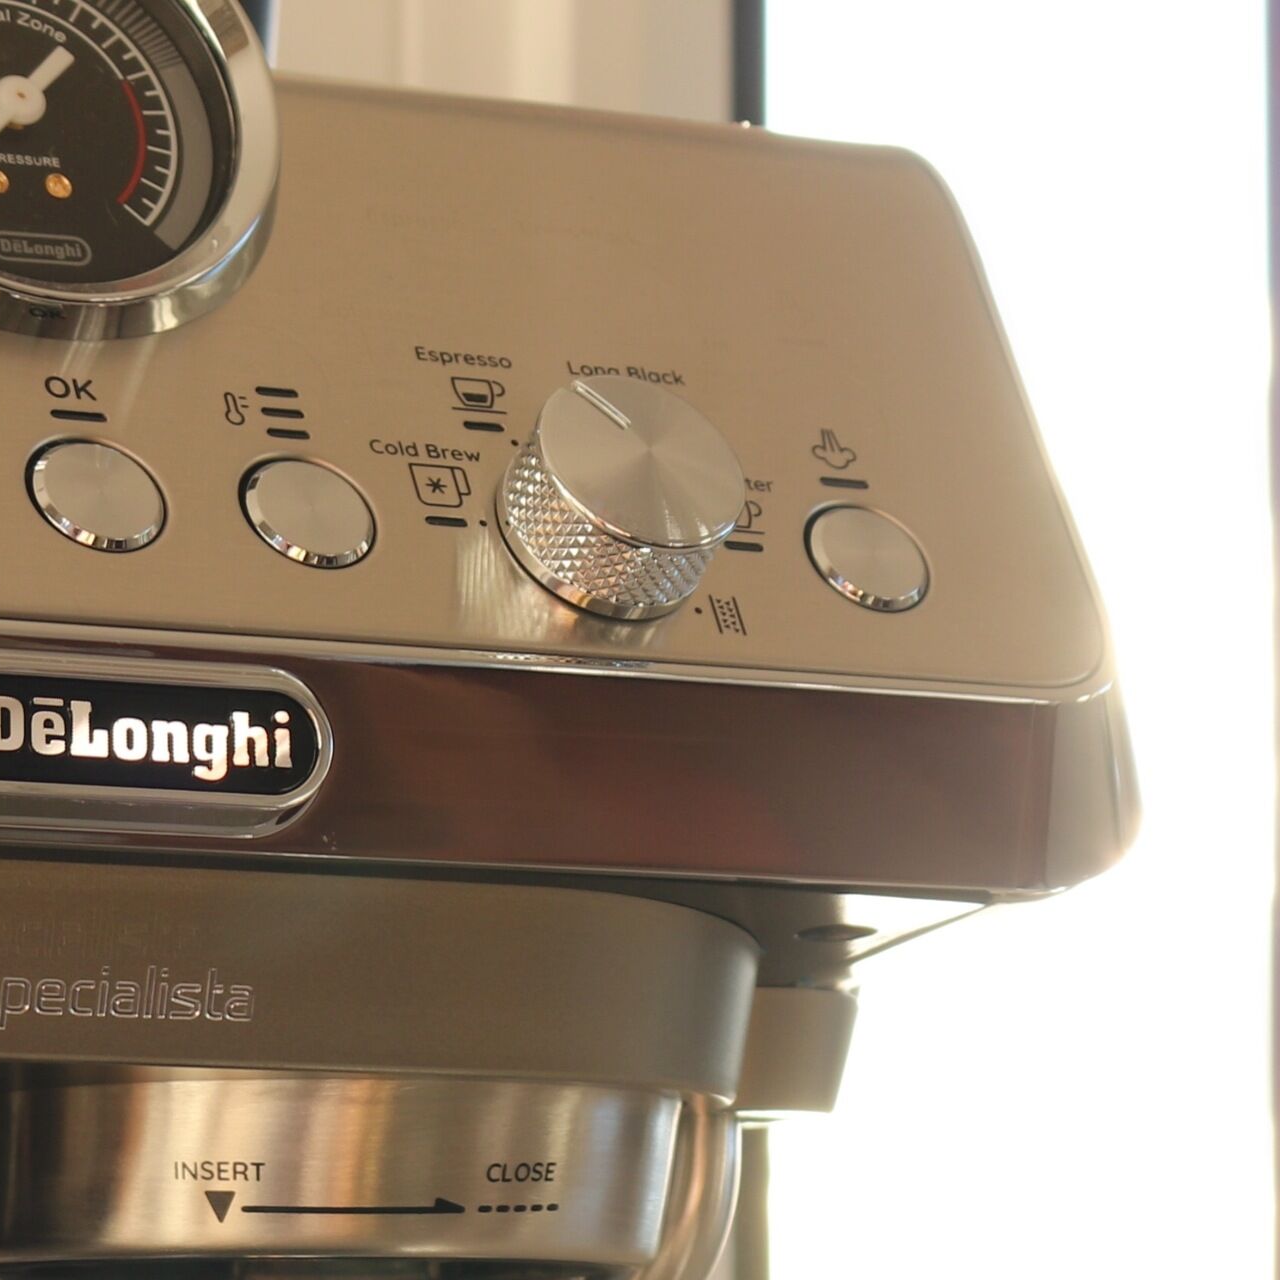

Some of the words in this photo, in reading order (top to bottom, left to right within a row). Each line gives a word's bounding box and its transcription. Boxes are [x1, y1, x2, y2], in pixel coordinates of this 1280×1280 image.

[17, 11, 67, 43] Zone
[414, 345, 512, 369] Espresso
[626, 365, 687, 386] Black
[45, 376, 99, 401] OK
[369, 439, 419, 457] Cold
[425, 443, 480, 462] Brew
[174, 1161, 266, 1182] INSERT
[486, 1161, 557, 1183] CLOSE
